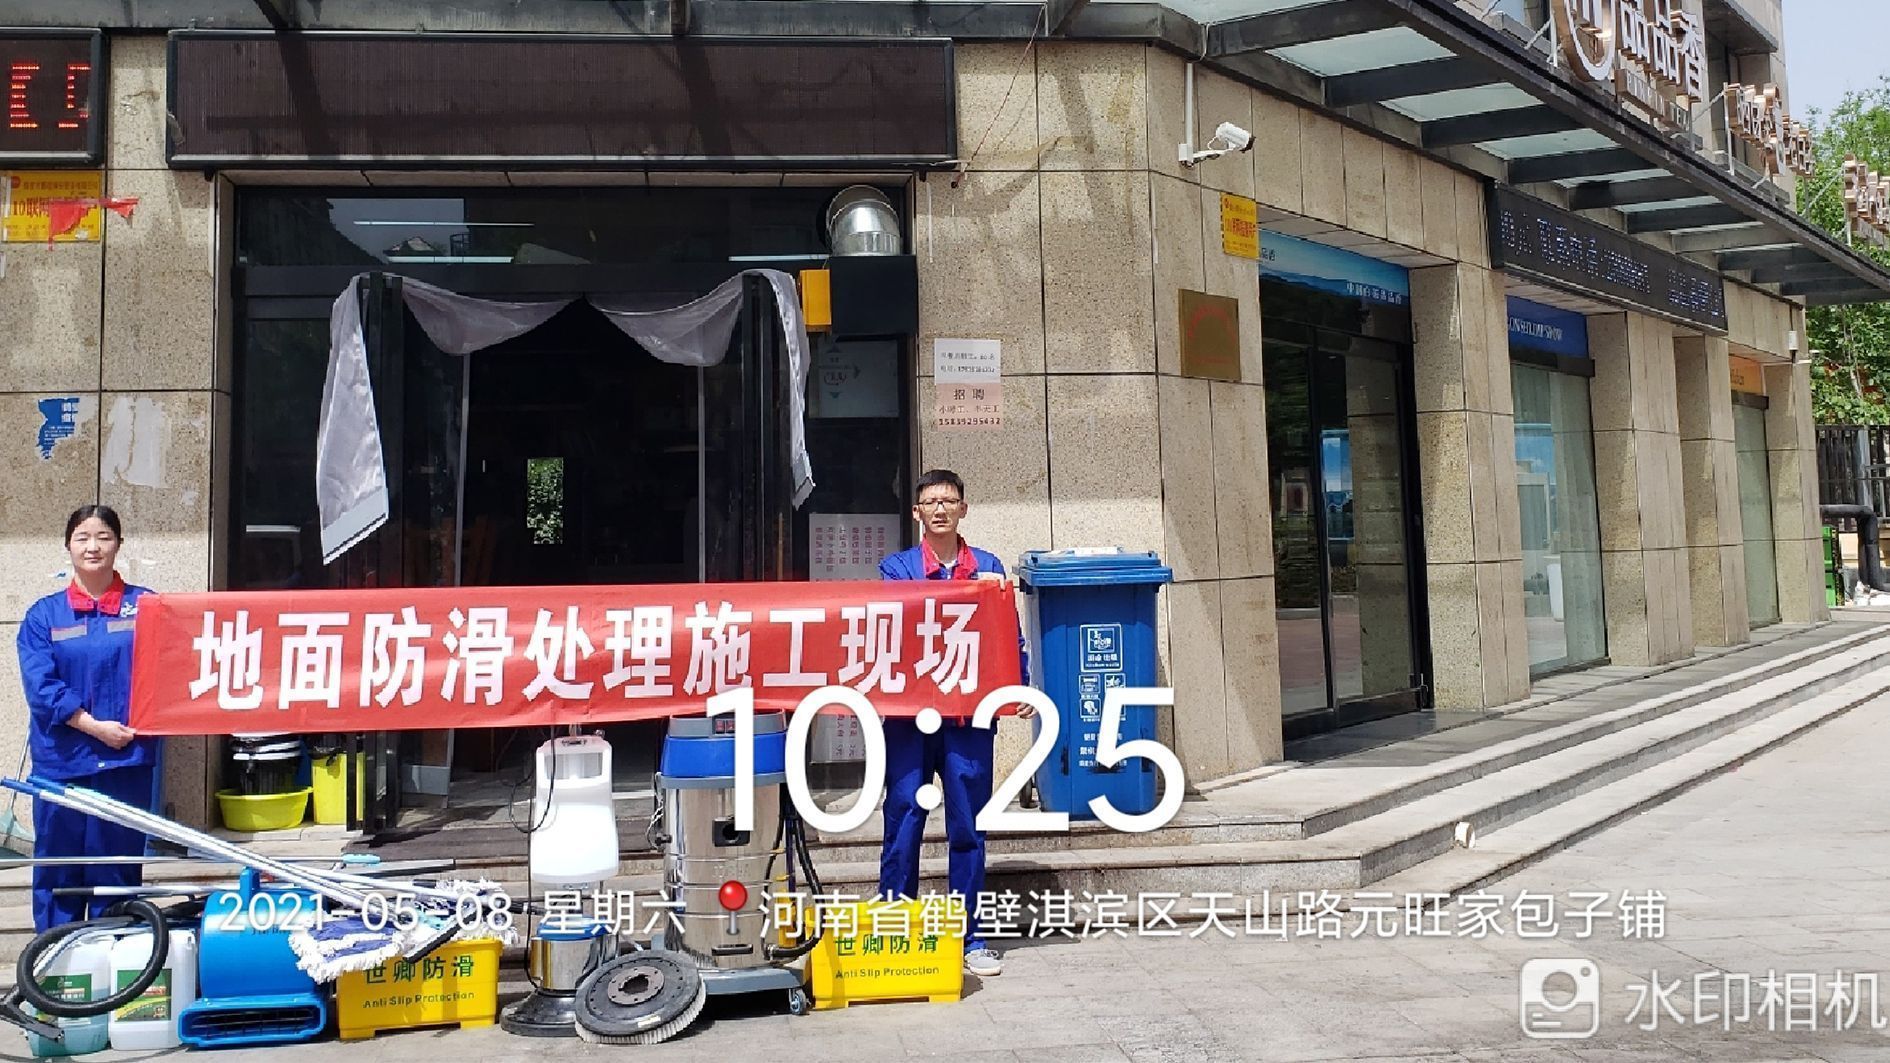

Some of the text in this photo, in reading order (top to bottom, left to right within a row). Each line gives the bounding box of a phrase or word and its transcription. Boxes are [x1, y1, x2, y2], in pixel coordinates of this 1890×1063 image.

[189, 598, 980, 710] 地面防滑处理施工现场
[363, 956, 475, 984] 世卿防滑
[835, 966, 940, 979] Anti Slip Protection
[363, 991, 475, 1009] Anti Slip Protection
